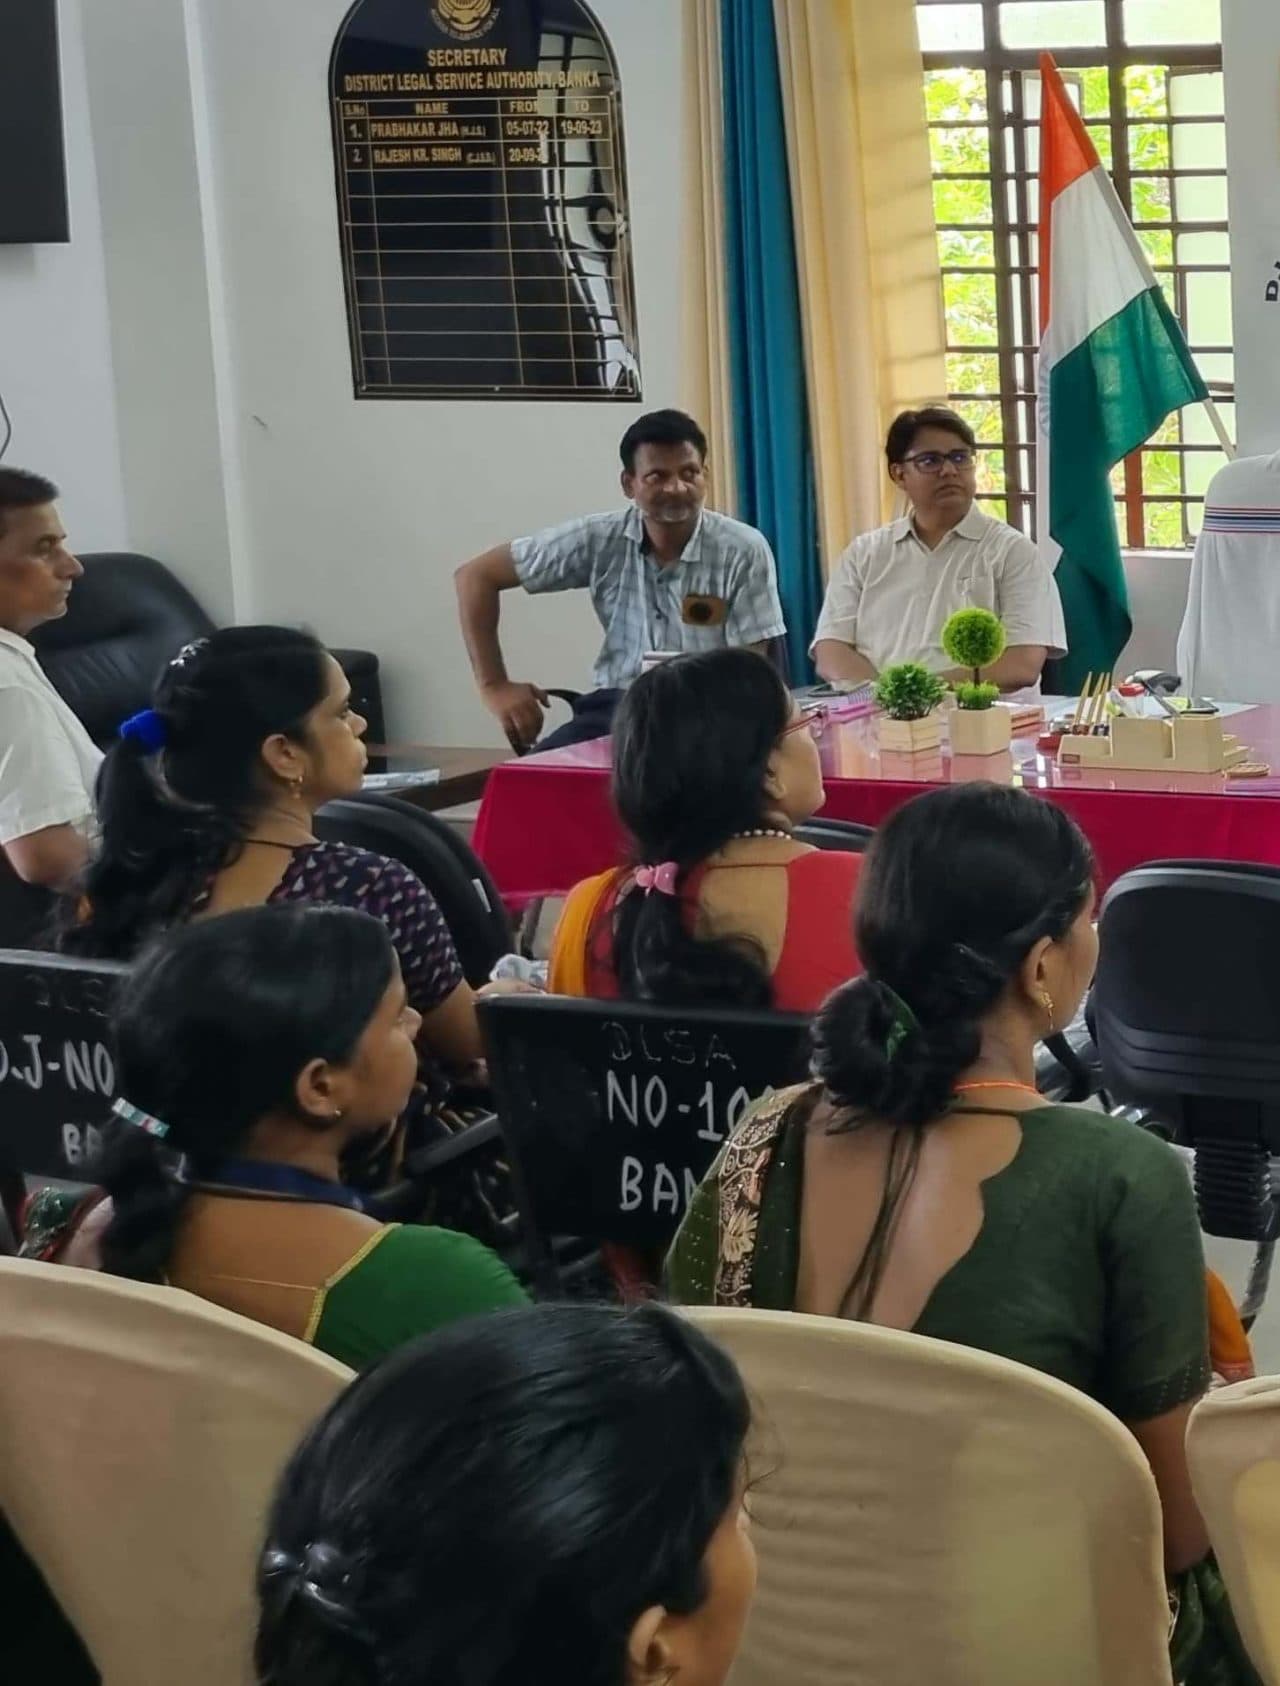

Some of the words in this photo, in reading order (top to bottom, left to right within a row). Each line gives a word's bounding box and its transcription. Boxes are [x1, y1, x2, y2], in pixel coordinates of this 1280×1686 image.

[427, 48, 507, 67] SECRETARY
[344, 74, 394, 92] DISTRICT
[397, 73, 433, 91] LEGAL
[436, 72, 483, 90] SERVICE
[559, 70, 600, 88] BANKA
[415, 102, 449, 114] NAME
[510, 101, 540, 113] FRO
[575, 101, 590, 112] TO
[349, 123, 363, 138] 1.
[371, 122, 436, 137] PRABHAKAR
[438, 121, 460, 136] JHA
[374, 149, 411, 163] RAJESH
[432, 147, 463, 162] SINGH
[509, 147, 546, 162] 20-09-2
[601, 1021, 737, 1070] DLSA
[606, 1069, 776, 1142] NO-10
